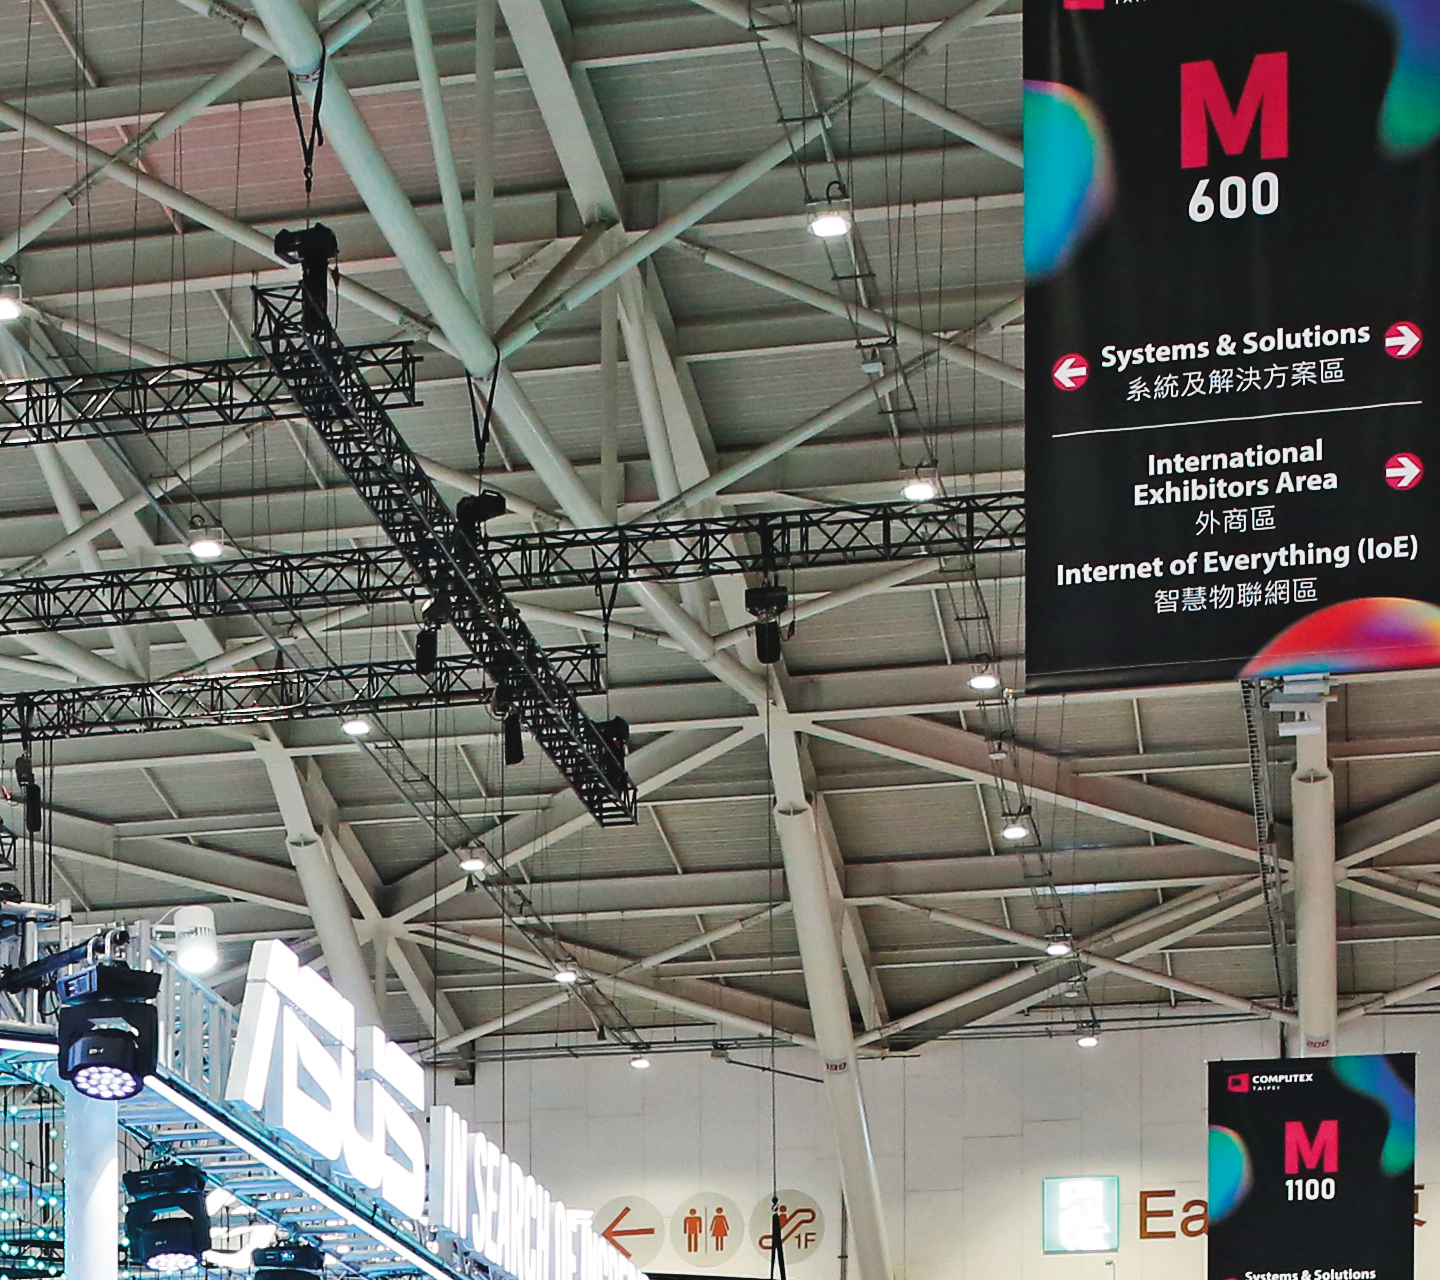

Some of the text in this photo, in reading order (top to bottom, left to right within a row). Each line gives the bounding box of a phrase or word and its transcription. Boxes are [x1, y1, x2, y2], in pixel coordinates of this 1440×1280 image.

[1181, 51, 1289, 169] M
[1188, 172, 1280, 223] 600
[1101, 324, 1371, 371] Systems & Solutions
[1126, 358, 1345, 402] 系統及解決方案區
[1147, 439, 1324, 476] International
[1133, 470, 1339, 506] Exhibitors Area
[1195, 505, 1276, 537] 外商區
[1056, 535, 1418, 586] Internet of Everything (IoE)
[1154, 577, 1319, 614] 智慧物聯網區
[225, 939, 426, 1220] ASUS
[1252, 1073, 1314, 1084] COMPUTEX
[1284, 1119, 1339, 1174] M
[1285, 1177, 1336, 1201] 1100
[794, 1233, 816, 1250] 1F
[1314, 1268, 1376, 1280] Solutions
